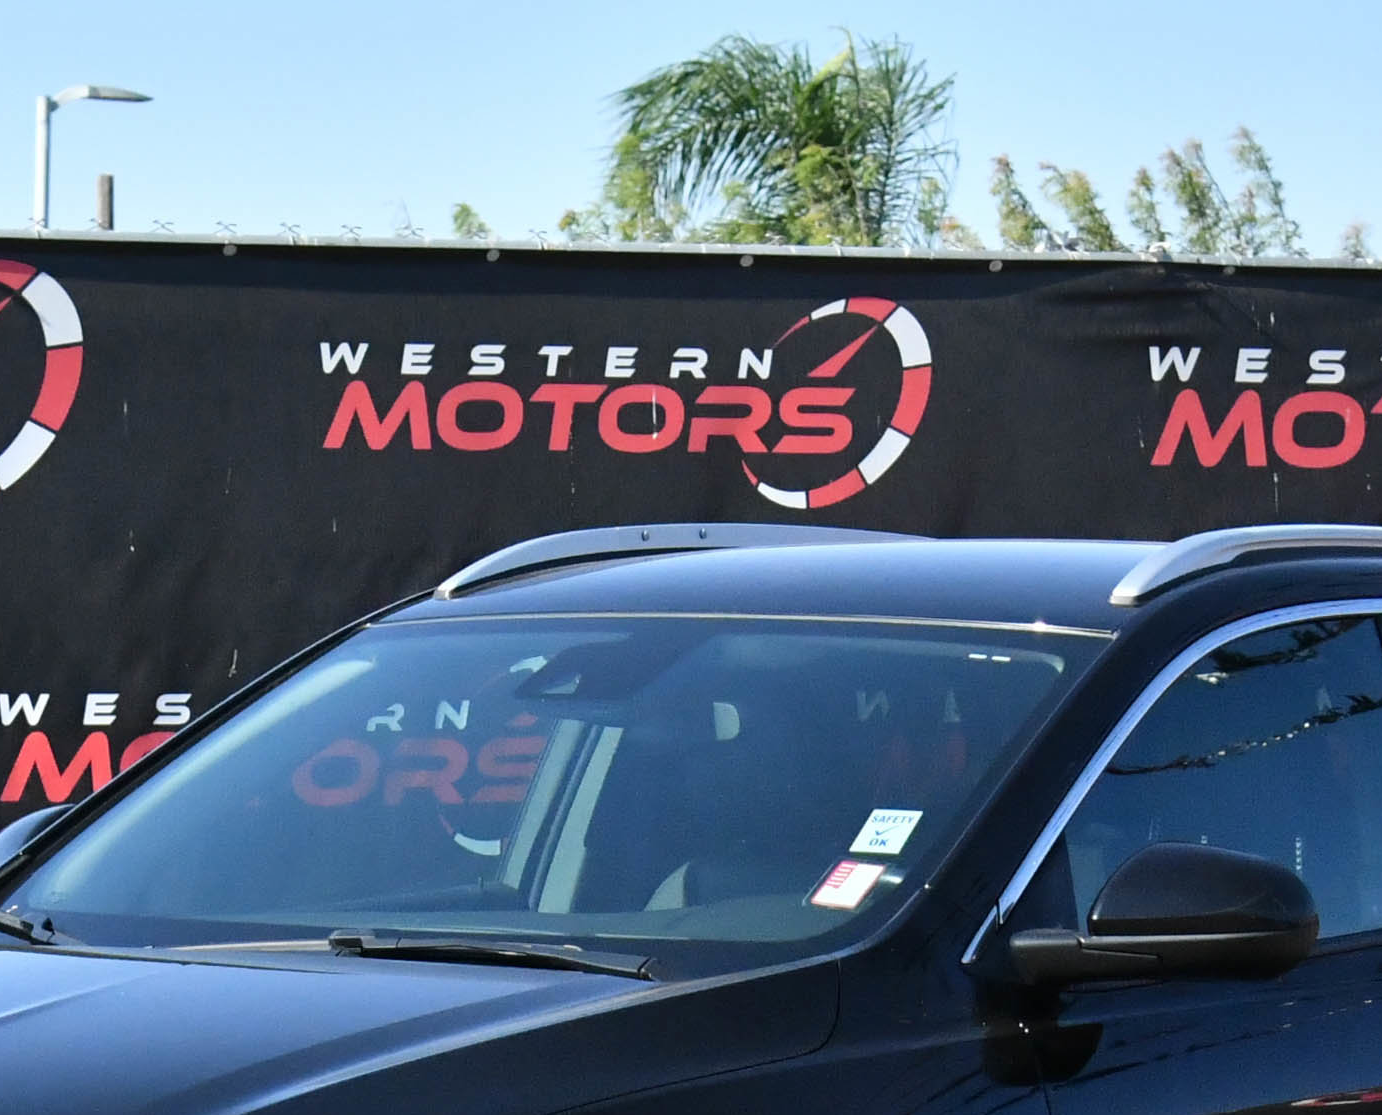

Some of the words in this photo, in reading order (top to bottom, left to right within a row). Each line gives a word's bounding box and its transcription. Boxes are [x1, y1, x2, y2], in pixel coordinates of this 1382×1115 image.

[319, 341, 774, 380] WESTERN
[322, 380, 856, 455] MOTORS
[871, 815, 915, 824] SAFETY
[869, 838, 889, 846] OK
